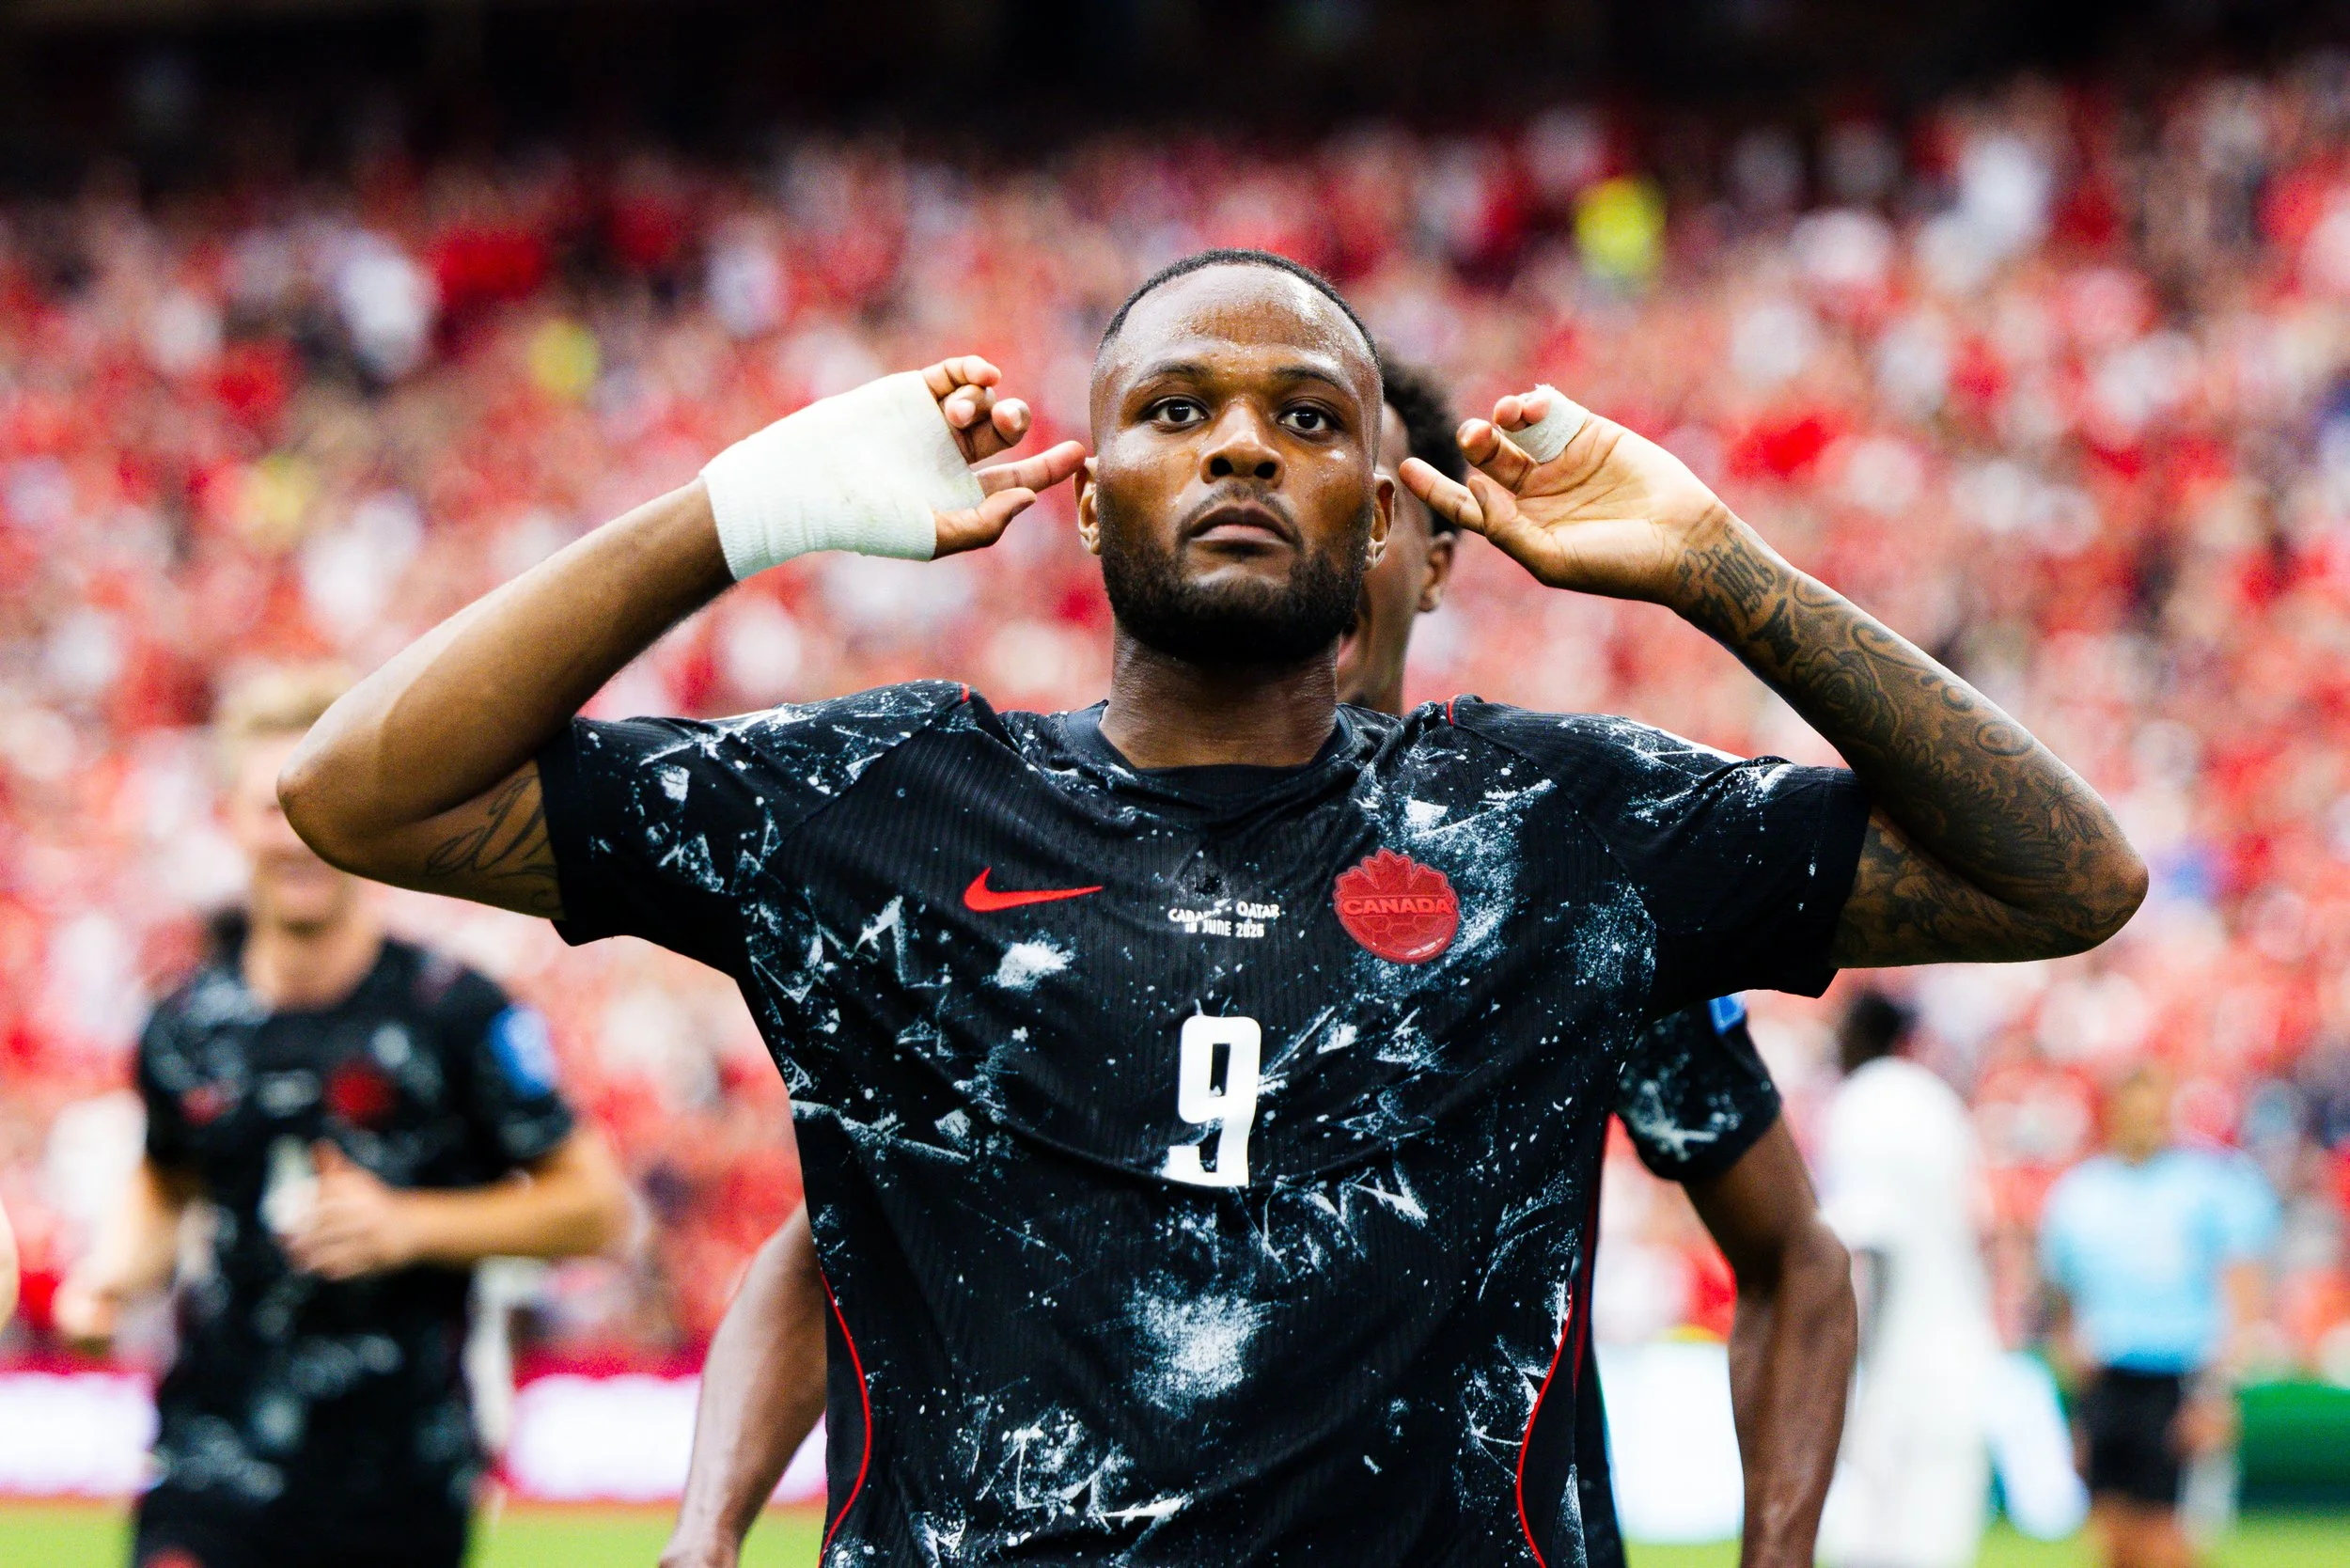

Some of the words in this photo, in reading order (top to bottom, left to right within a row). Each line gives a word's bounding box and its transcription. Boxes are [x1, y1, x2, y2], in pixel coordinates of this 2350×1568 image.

[1236, 901, 1280, 918] QATAR
[1342, 898, 1453, 915] CANADA
[1202, 919, 1231, 936] JUNE
[1235, 922, 1264, 938] 2026
[1167, 1014, 1261, 1187] 9
